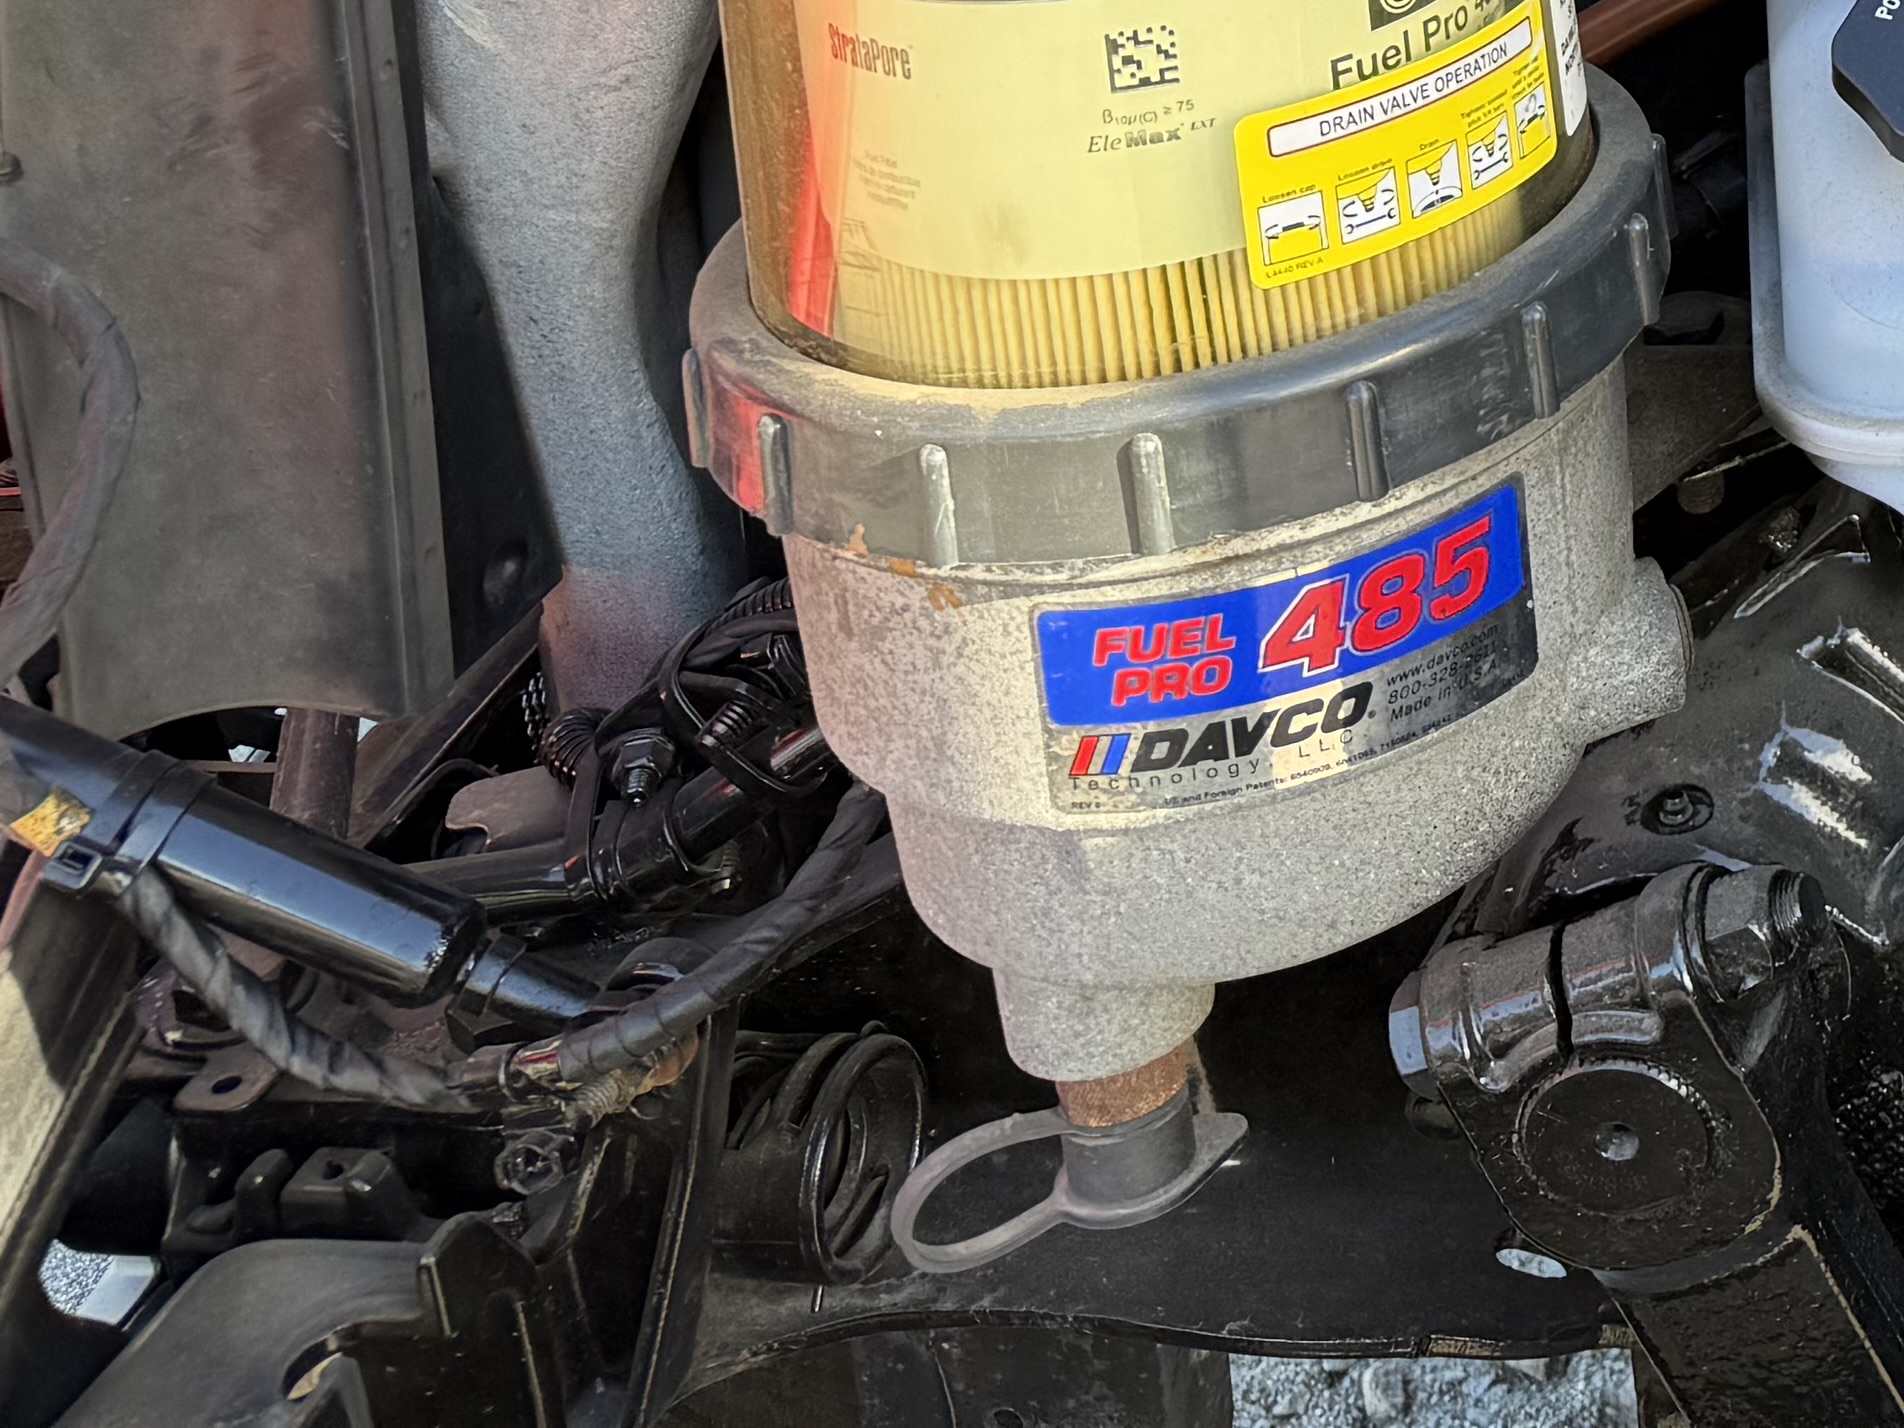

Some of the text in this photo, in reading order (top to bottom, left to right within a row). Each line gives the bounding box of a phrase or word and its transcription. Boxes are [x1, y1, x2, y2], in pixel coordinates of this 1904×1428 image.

[1330, 30, 1412, 91] Fuel
[1422, 5, 1468, 53] Pro
[1175, 98, 1195, 113] 75
[1319, 104, 1376, 138] DRAIN
[1379, 81, 1431, 119] VALVE
[1434, 42, 1509, 93] OPERATION
[1258, 514, 1493, 677] 485
[1092, 612, 1238, 668] FUEL
[1110, 656, 1235, 708] PRO
[1390, 695, 1433, 722] Made
[1129, 681, 1375, 774] DAVCO
